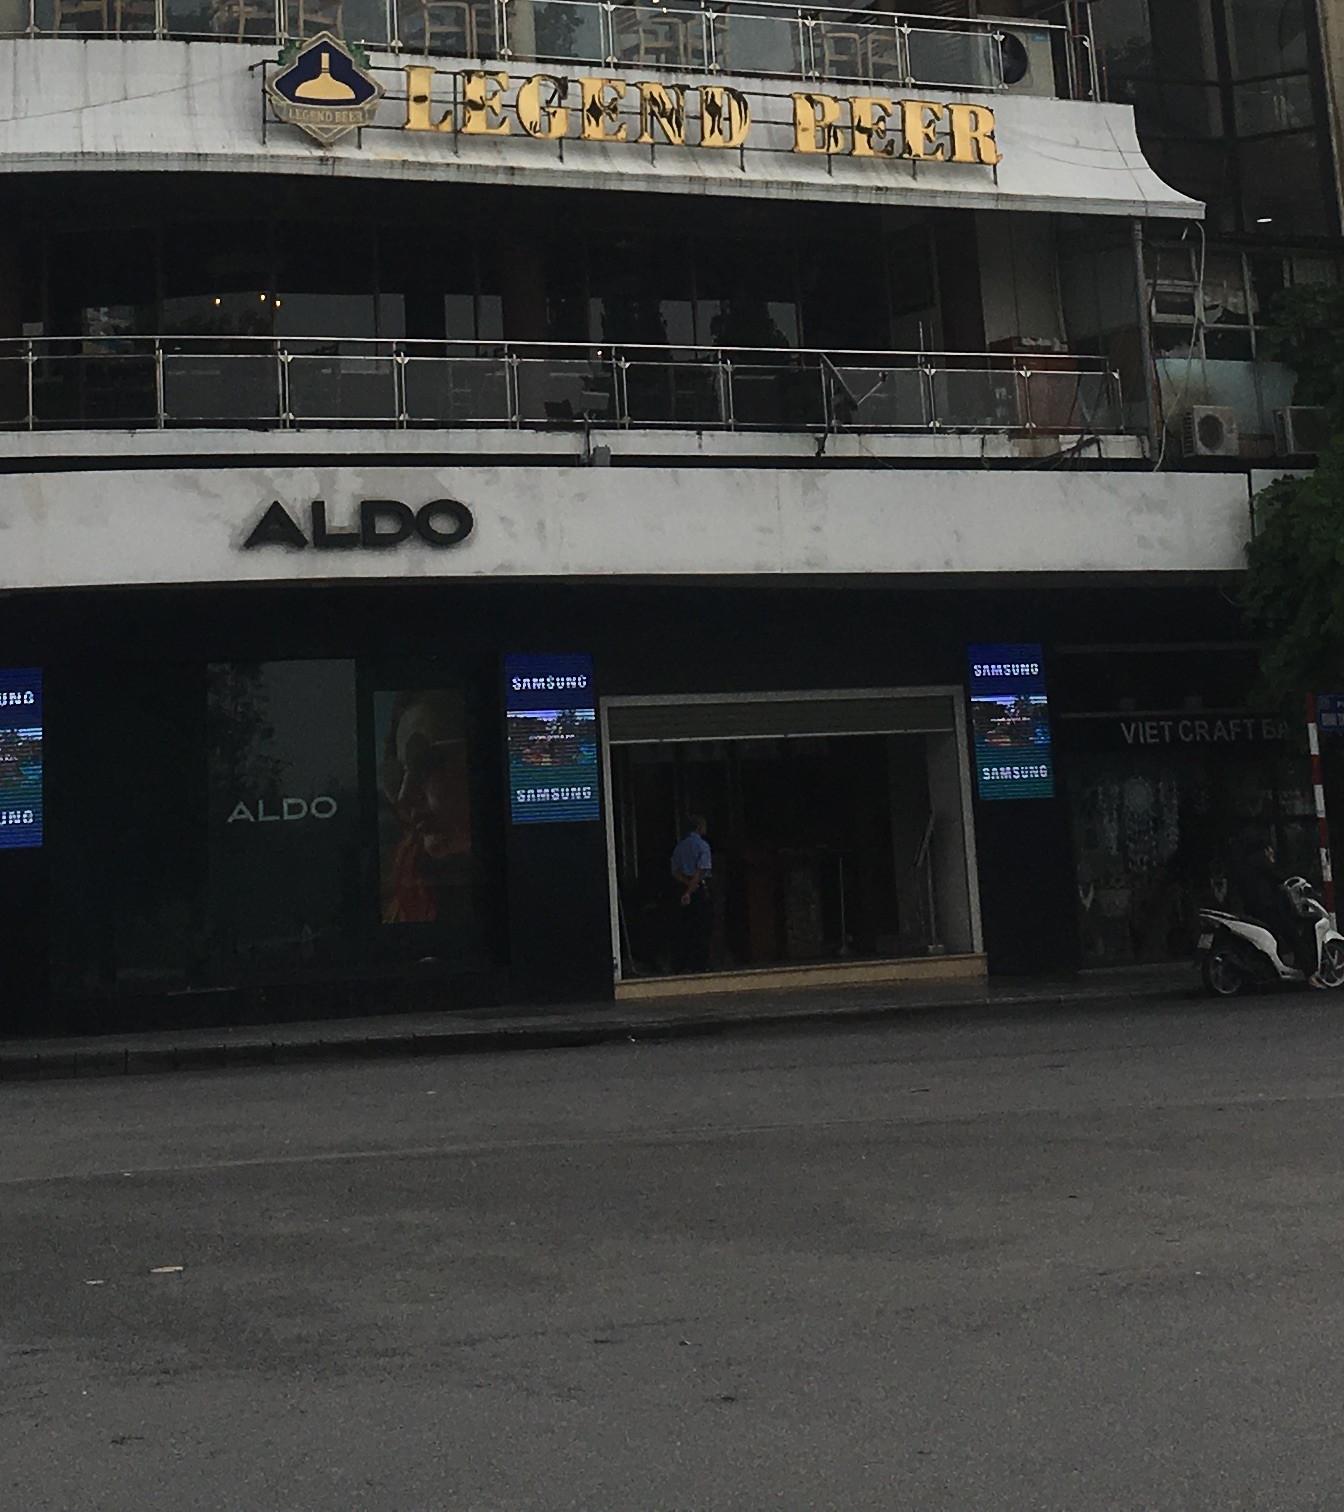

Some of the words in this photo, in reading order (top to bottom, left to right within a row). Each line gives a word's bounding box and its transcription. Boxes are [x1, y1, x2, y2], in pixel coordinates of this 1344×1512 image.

[289, 108, 333, 122] LEGEND
[335, 110, 363, 123] BEER
[403, 65, 752, 150] LEGEND
[792, 92, 1003, 166] BEER
[242, 498, 475, 552] ALDO
[973, 662, 1039, 677] SAMSUNG
[511, 674, 587, 691] SAMSUNG
[1120, 720, 1173, 745] VIET
[1177, 718, 1256, 743] CRAFT
[982, 764, 1048, 781] SAMSUNG
[516, 786, 592, 803] SAMSUNG
[225, 795, 338, 823] ALDO
